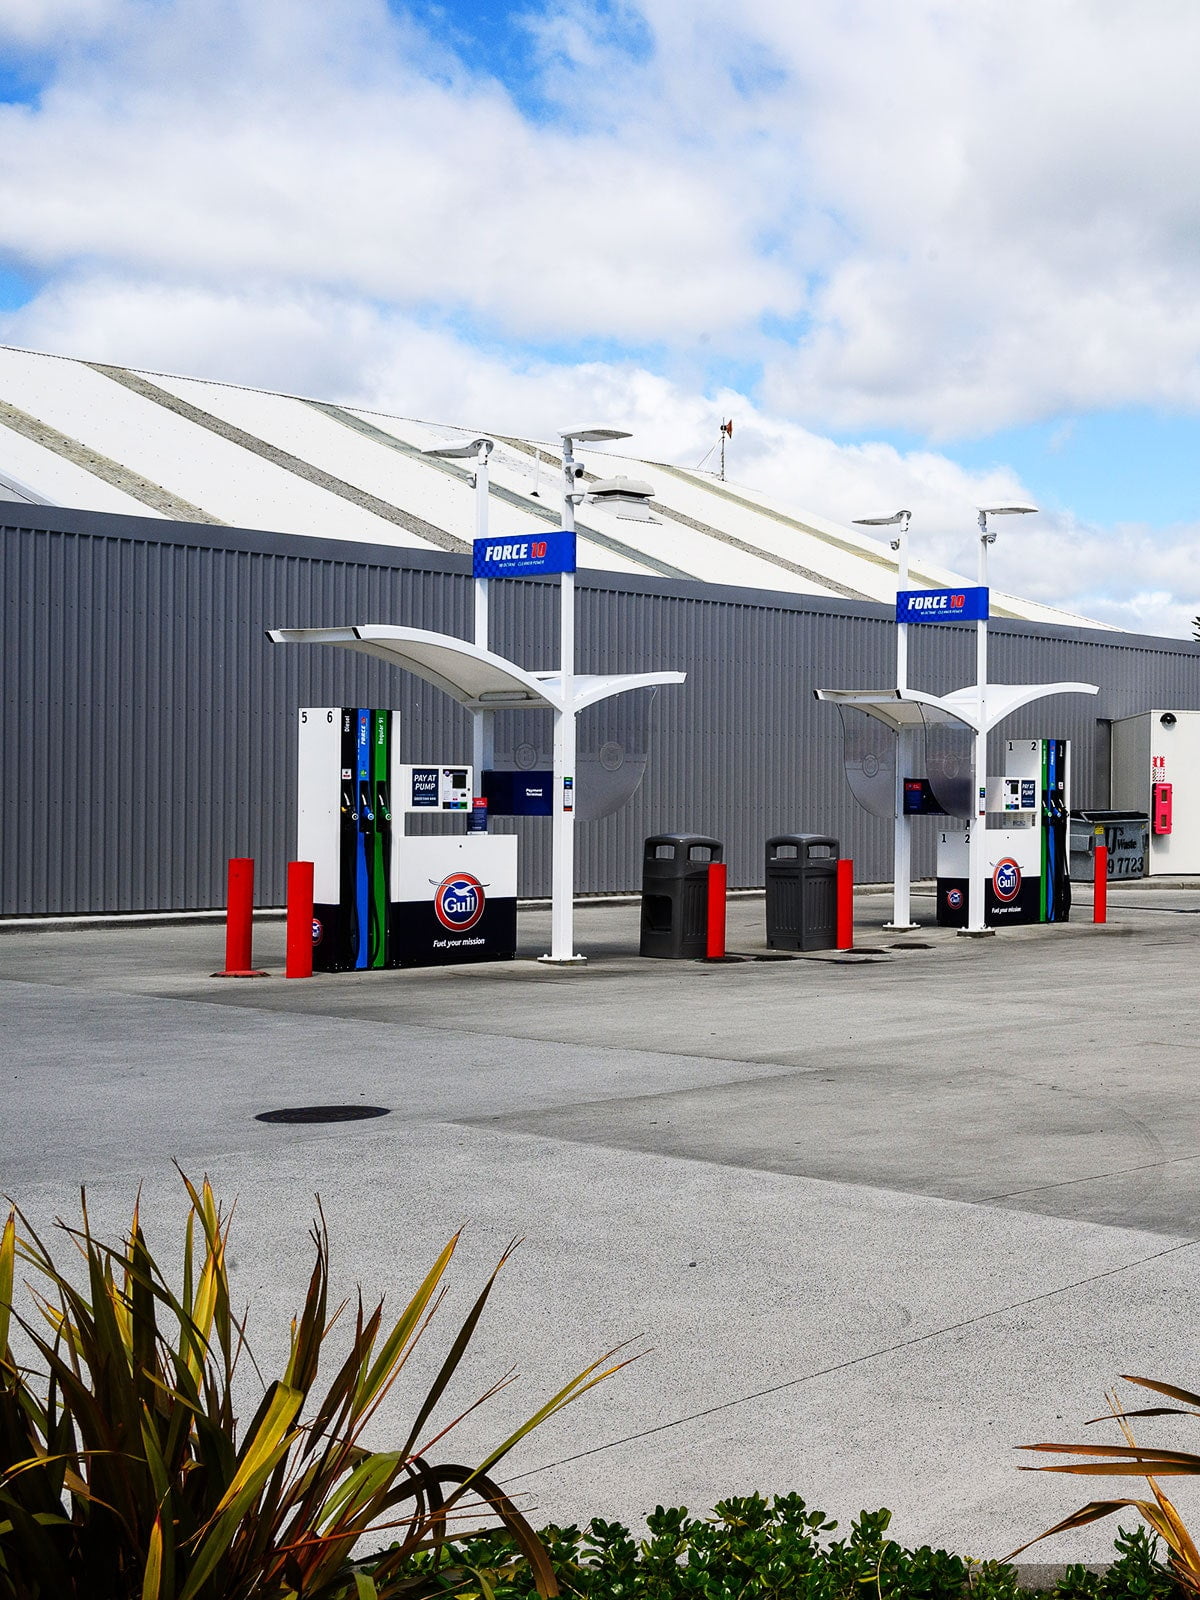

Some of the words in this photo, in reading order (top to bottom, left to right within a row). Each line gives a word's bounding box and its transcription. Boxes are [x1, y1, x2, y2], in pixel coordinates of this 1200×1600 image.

[485, 543, 528, 562] FORCE
[531, 541, 547, 558] 10
[908, 596, 948, 610] FORCE
[950, 595, 965, 608] 10
[301, 711, 308, 724] 5
[327, 711, 333, 724] 6
[1008, 741, 1014, 751] 1
[1030, 741, 1037, 751] 2
[414, 774, 427, 782] PAY
[427, 774, 437, 782] AT
[415, 783, 436, 791] PUMP
[942, 833, 947, 843] 1
[965, 834, 970, 843] 2
[1117, 857, 1144, 874] 7723
[998, 875, 1016, 888] Gull
[444, 897, 475, 913] Gull
[433, 939, 447, 947] Fuel
[446, 940, 462, 949] your
[462, 937, 486, 945] mission
